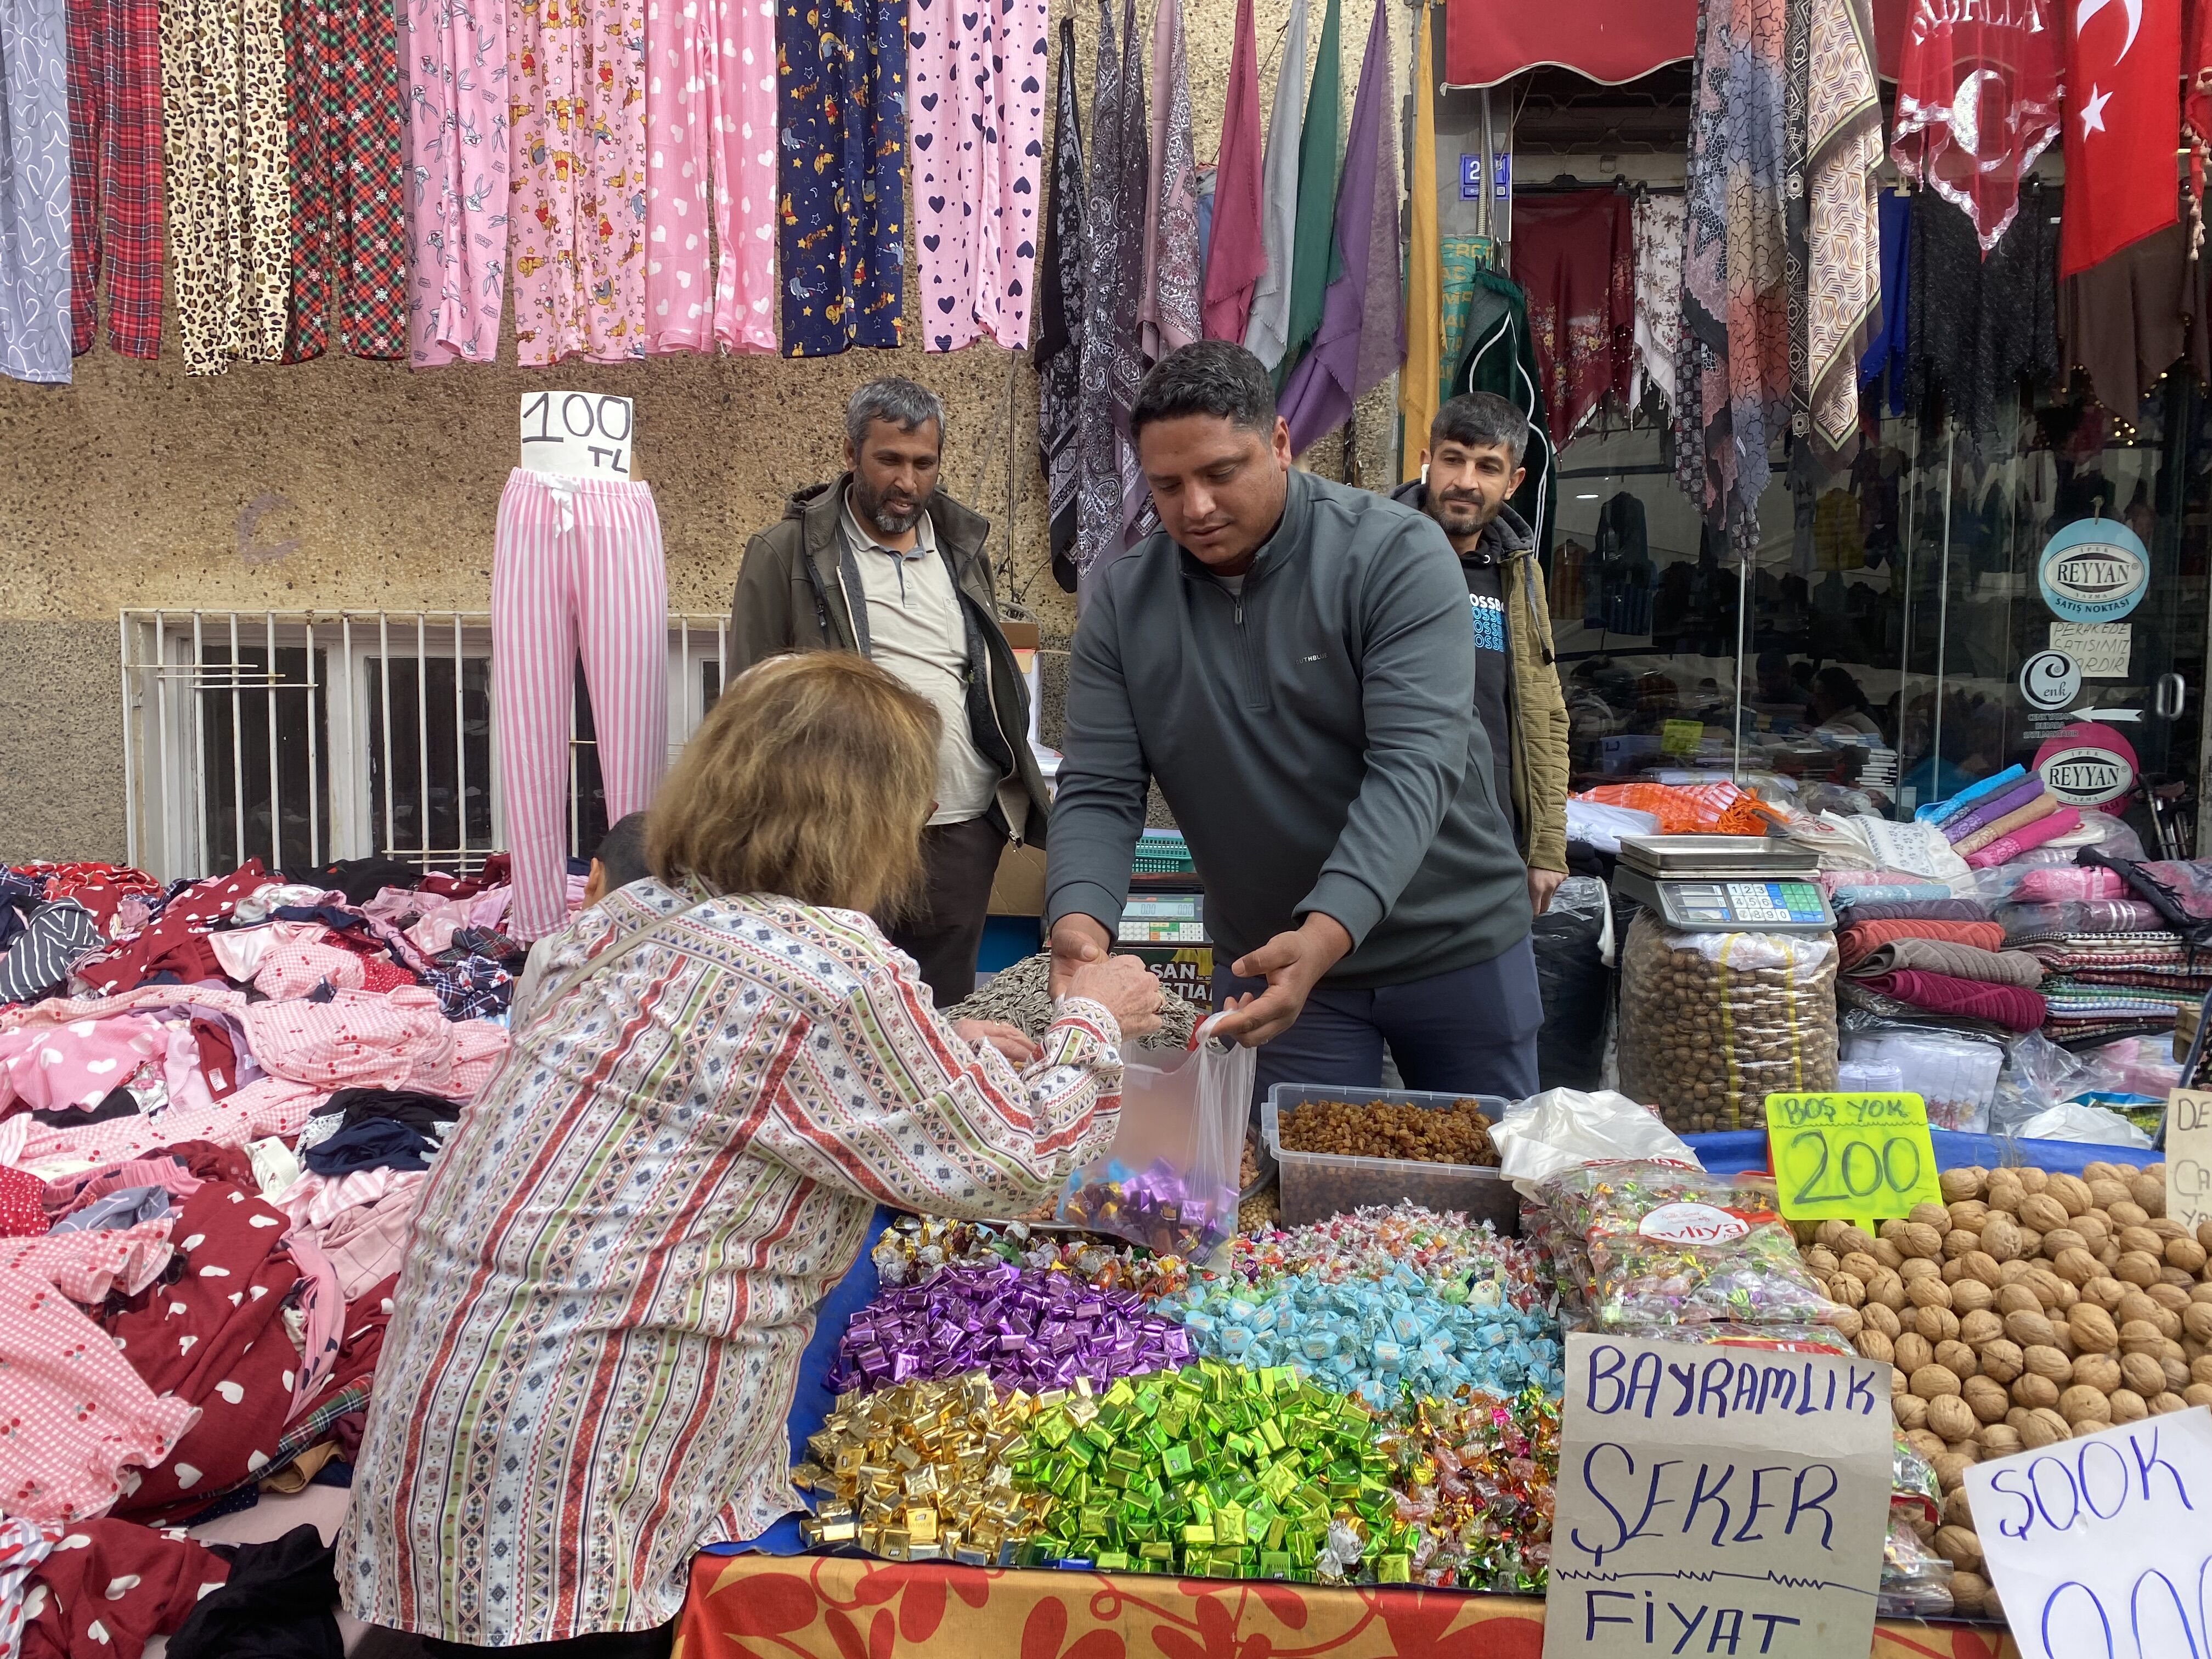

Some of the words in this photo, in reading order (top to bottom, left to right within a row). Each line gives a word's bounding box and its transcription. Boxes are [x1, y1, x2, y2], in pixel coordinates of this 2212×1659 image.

[522, 393, 631, 443] 100
[588, 445, 628, 473] TL
[2058, 563, 2130, 583] REYYAN
[2056, 598, 2082, 613] SATIŞ
[2085, 599, 2130, 613] NOKTASI
[2054, 622, 2129, 636] PERAKEDE
[2076, 657, 2125, 673] ARDIR
[2050, 766, 2120, 786] REYYAN
[1762, 898, 1769, 906] 6
[1150, 963, 1196, 979] SAN
[1784, 1097, 1836, 1124] BOŞ
[1847, 1099, 1909, 1122] YOK
[1791, 1129, 1920, 1205] 200
[1587, 1345, 1875, 1419] BAYRAMLIK
[1571, 1442, 1838, 1567] ŞEKER
[1585, 1590, 1801, 1655] FİYAT
